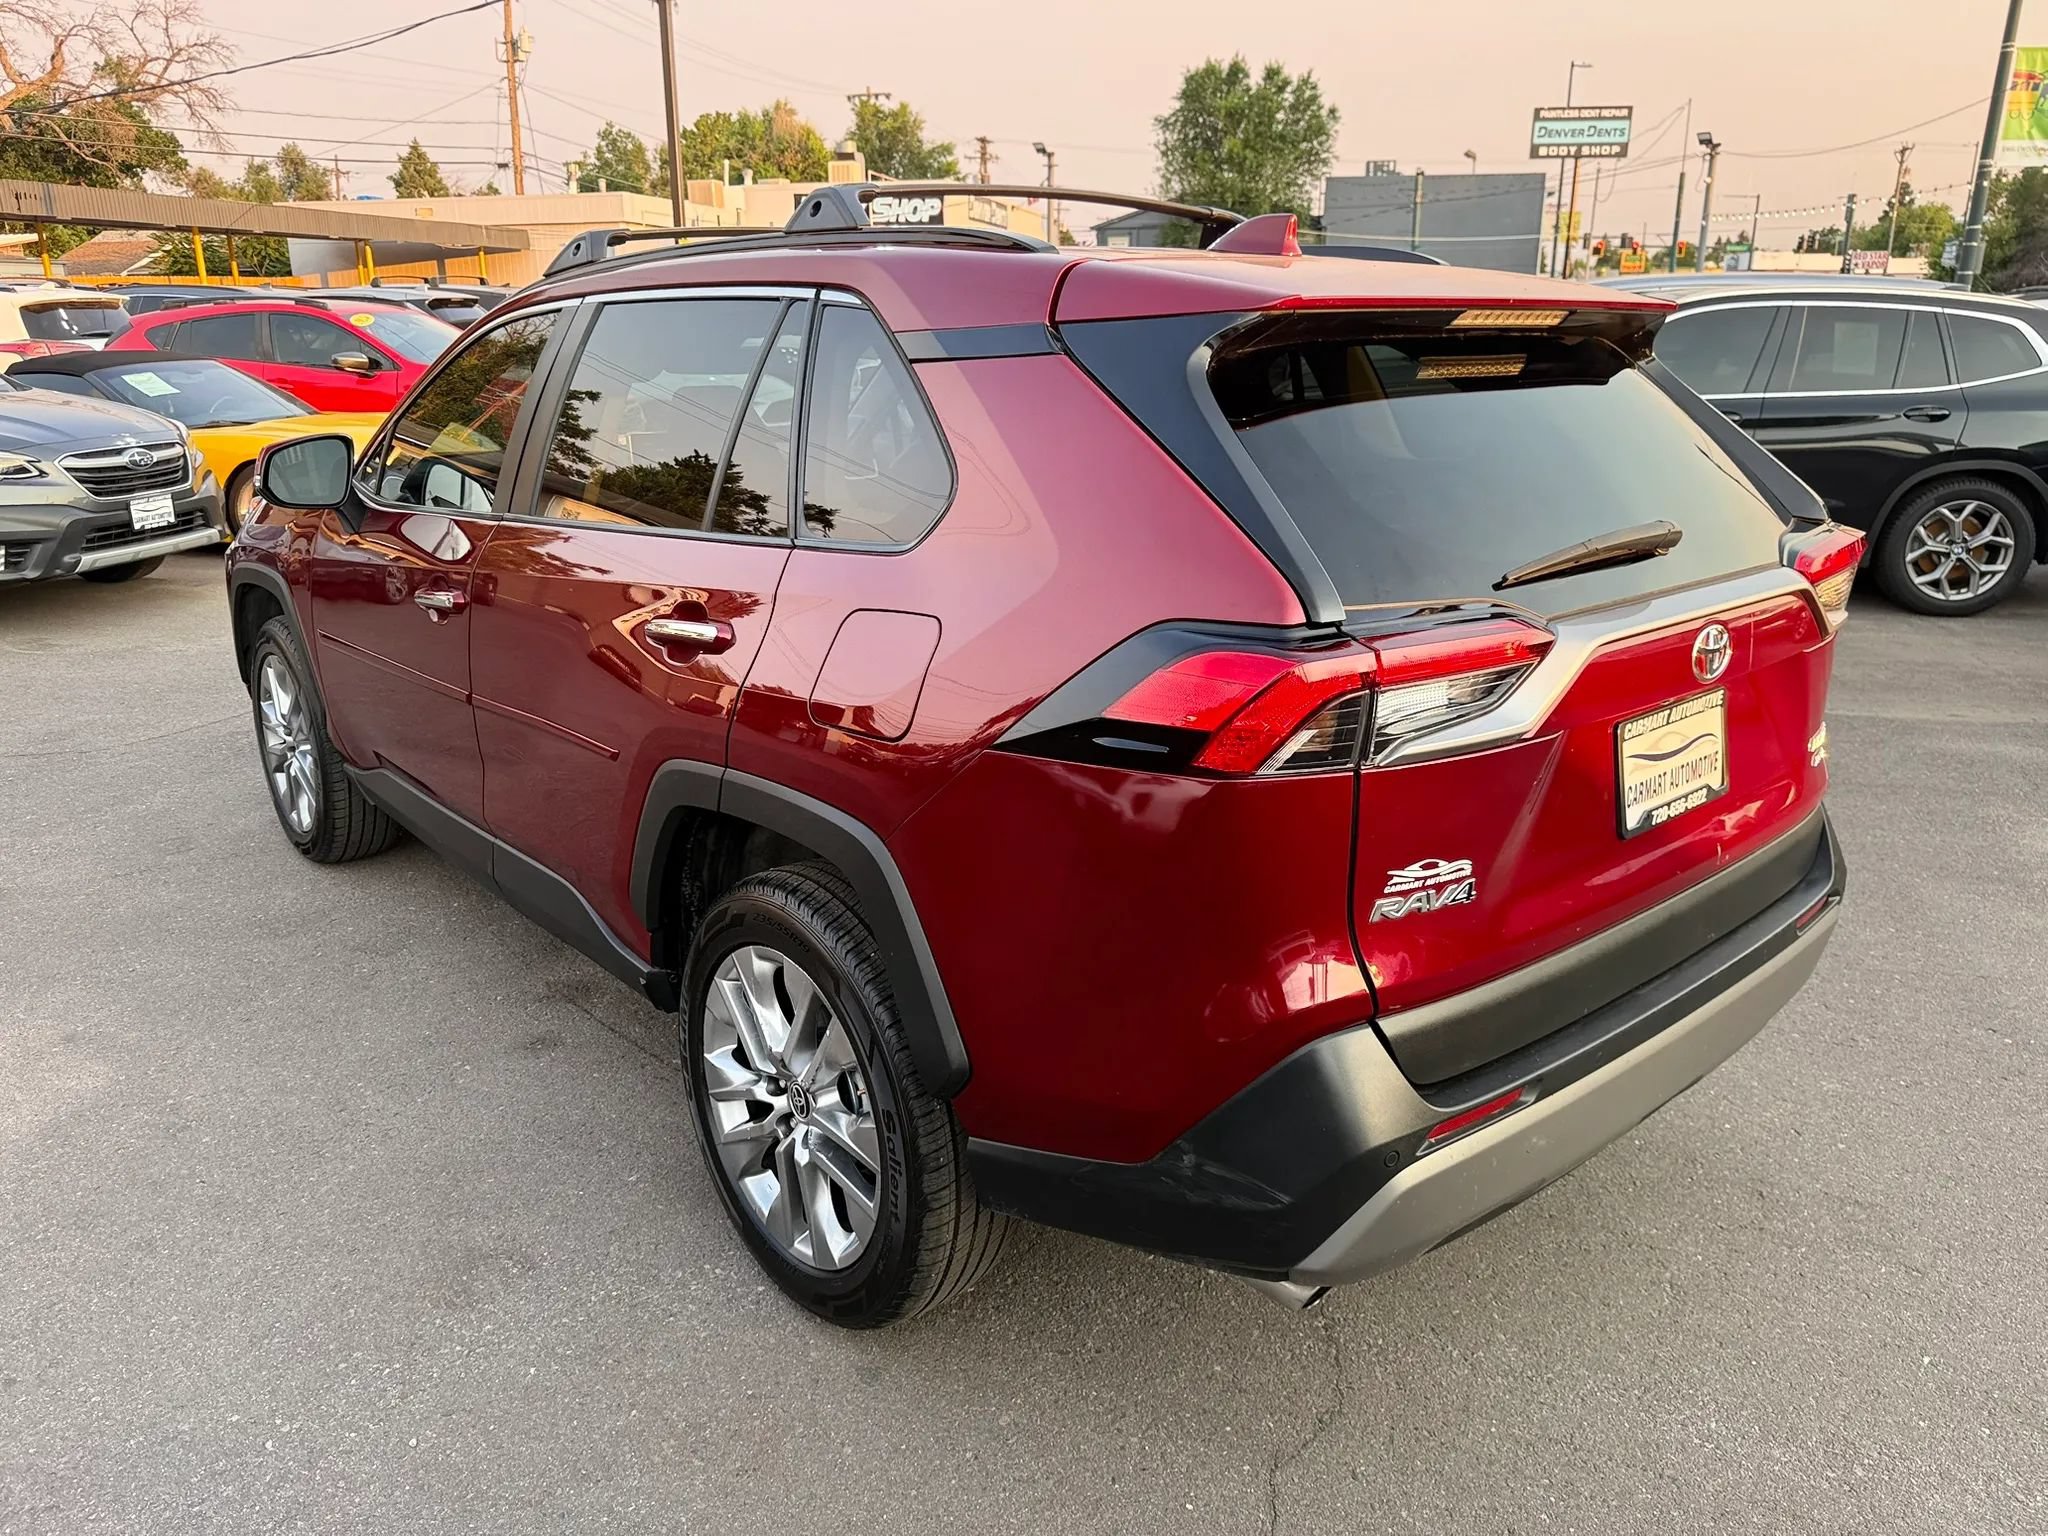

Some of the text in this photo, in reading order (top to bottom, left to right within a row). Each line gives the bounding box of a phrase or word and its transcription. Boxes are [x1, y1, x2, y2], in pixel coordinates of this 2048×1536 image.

[1539, 145, 1621, 156] BODY SHOP
[872, 196, 942, 223] SHOP
[1853, 250, 1889, 260] RED STAR
[1861, 259, 1888, 269] VAPOR
[1624, 689, 1725, 740] CARMART AUTOMOTIVE
[1626, 750, 1719, 809] CARMART AUTOMOTIVE
[1383, 868, 1472, 893] CARMART AUTOMOTIVE
[1368, 878, 1477, 924] RAV4
